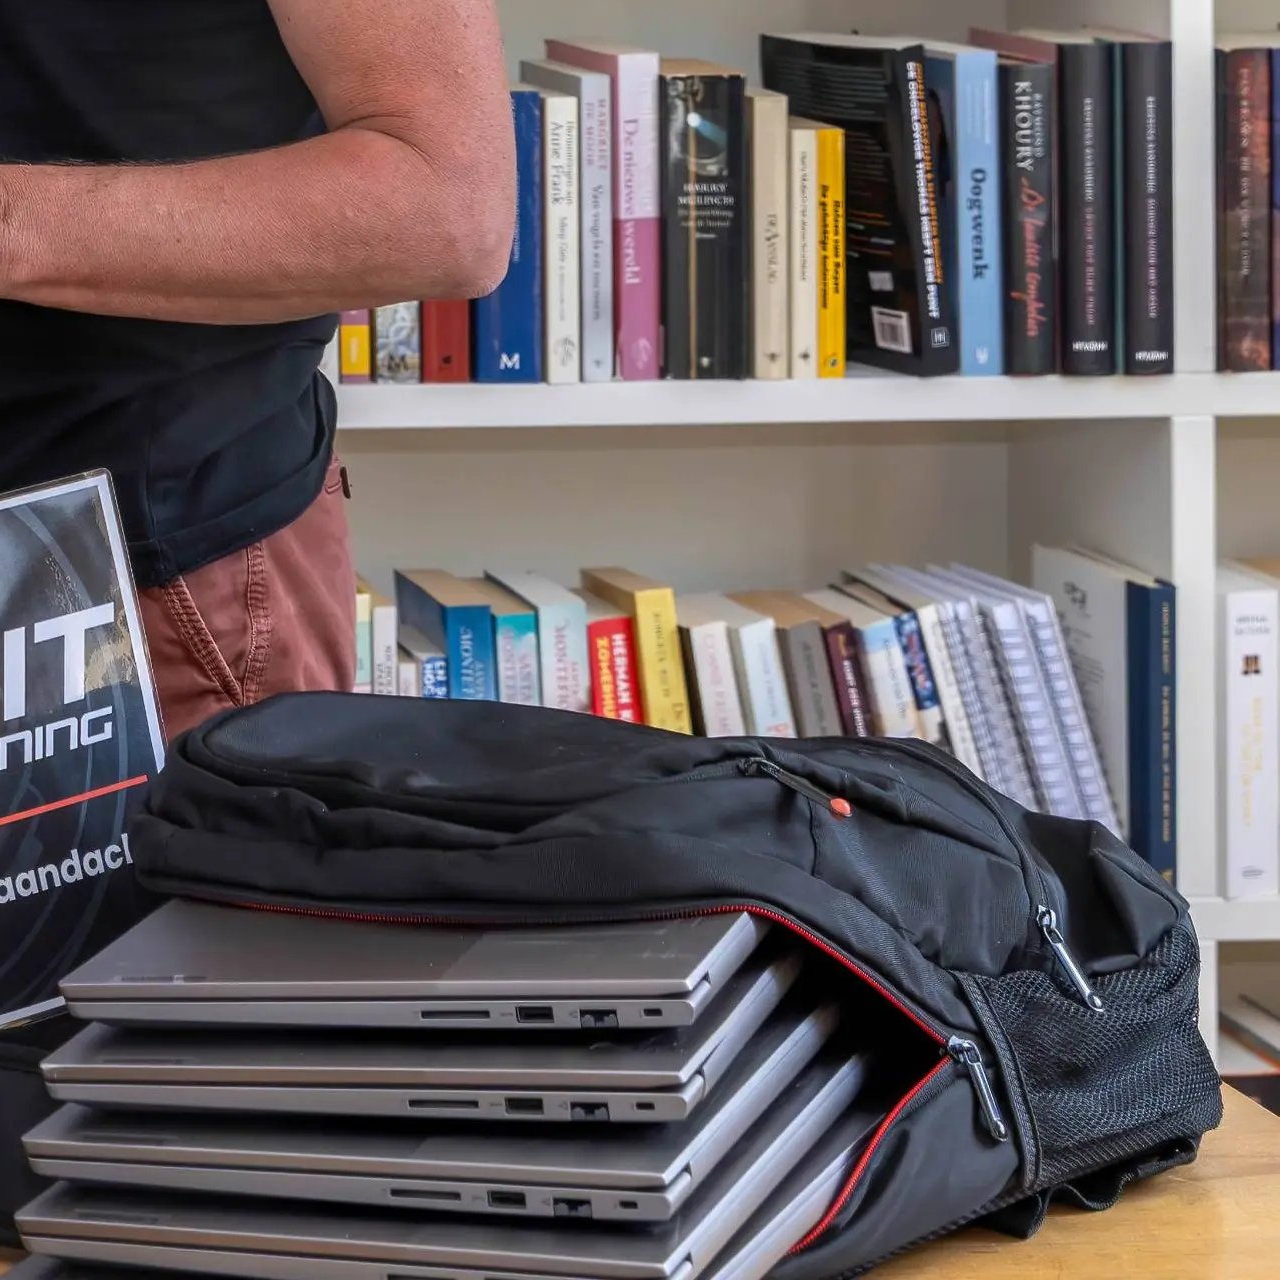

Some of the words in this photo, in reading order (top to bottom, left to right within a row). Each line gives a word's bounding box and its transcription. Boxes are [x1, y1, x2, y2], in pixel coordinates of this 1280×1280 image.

[550, 121, 565, 159] Anne
[623, 118, 639, 146] De
[1014, 81, 1033, 171] KHOURY
[551, 164, 565, 205] Frank
[623, 151, 639, 216] nieuwe
[623, 220, 641, 284] wereld
[966, 168, 989, 280] Oogwenk
[597, 637, 616, 718] ZOMERHU
[612, 633, 633, 704] HERMAN
